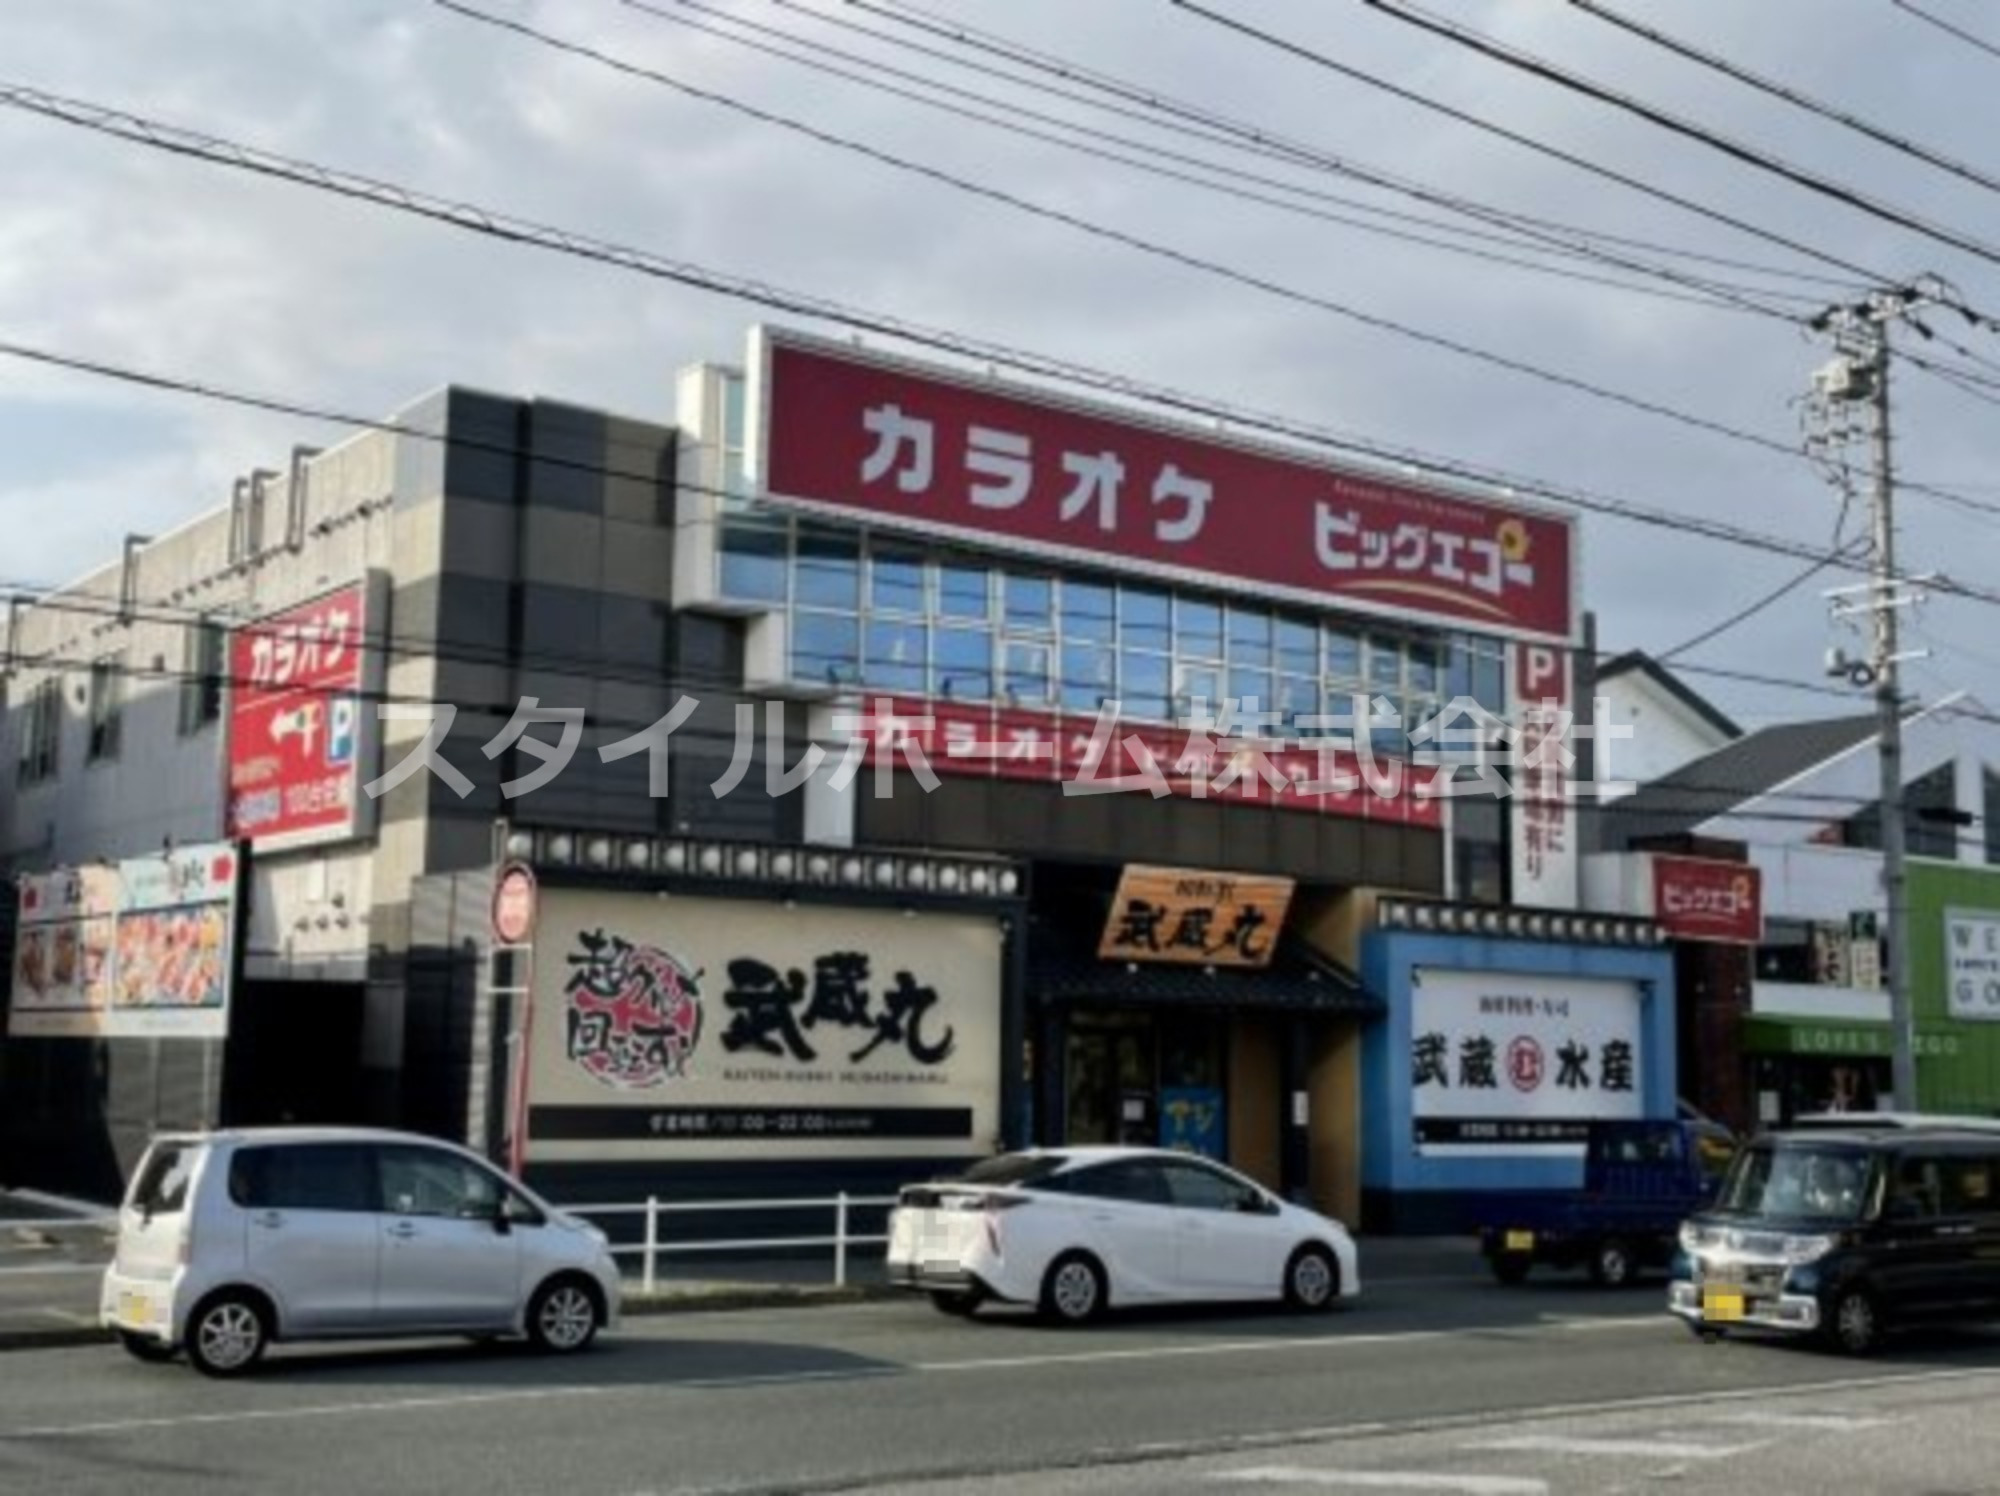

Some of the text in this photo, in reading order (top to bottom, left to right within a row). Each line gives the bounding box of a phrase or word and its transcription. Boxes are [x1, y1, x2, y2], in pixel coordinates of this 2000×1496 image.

[861, 403, 1213, 541] カラオケ
[1315, 502, 1534, 596] ビッグエコー
[252, 607, 350, 685] カラオケ
[1527, 647, 1557, 690] P
[330, 698, 353, 758] P
[1114, 899, 1270, 960] 武蔵丸
[719, 952, 955, 1065] 武蔵丸
